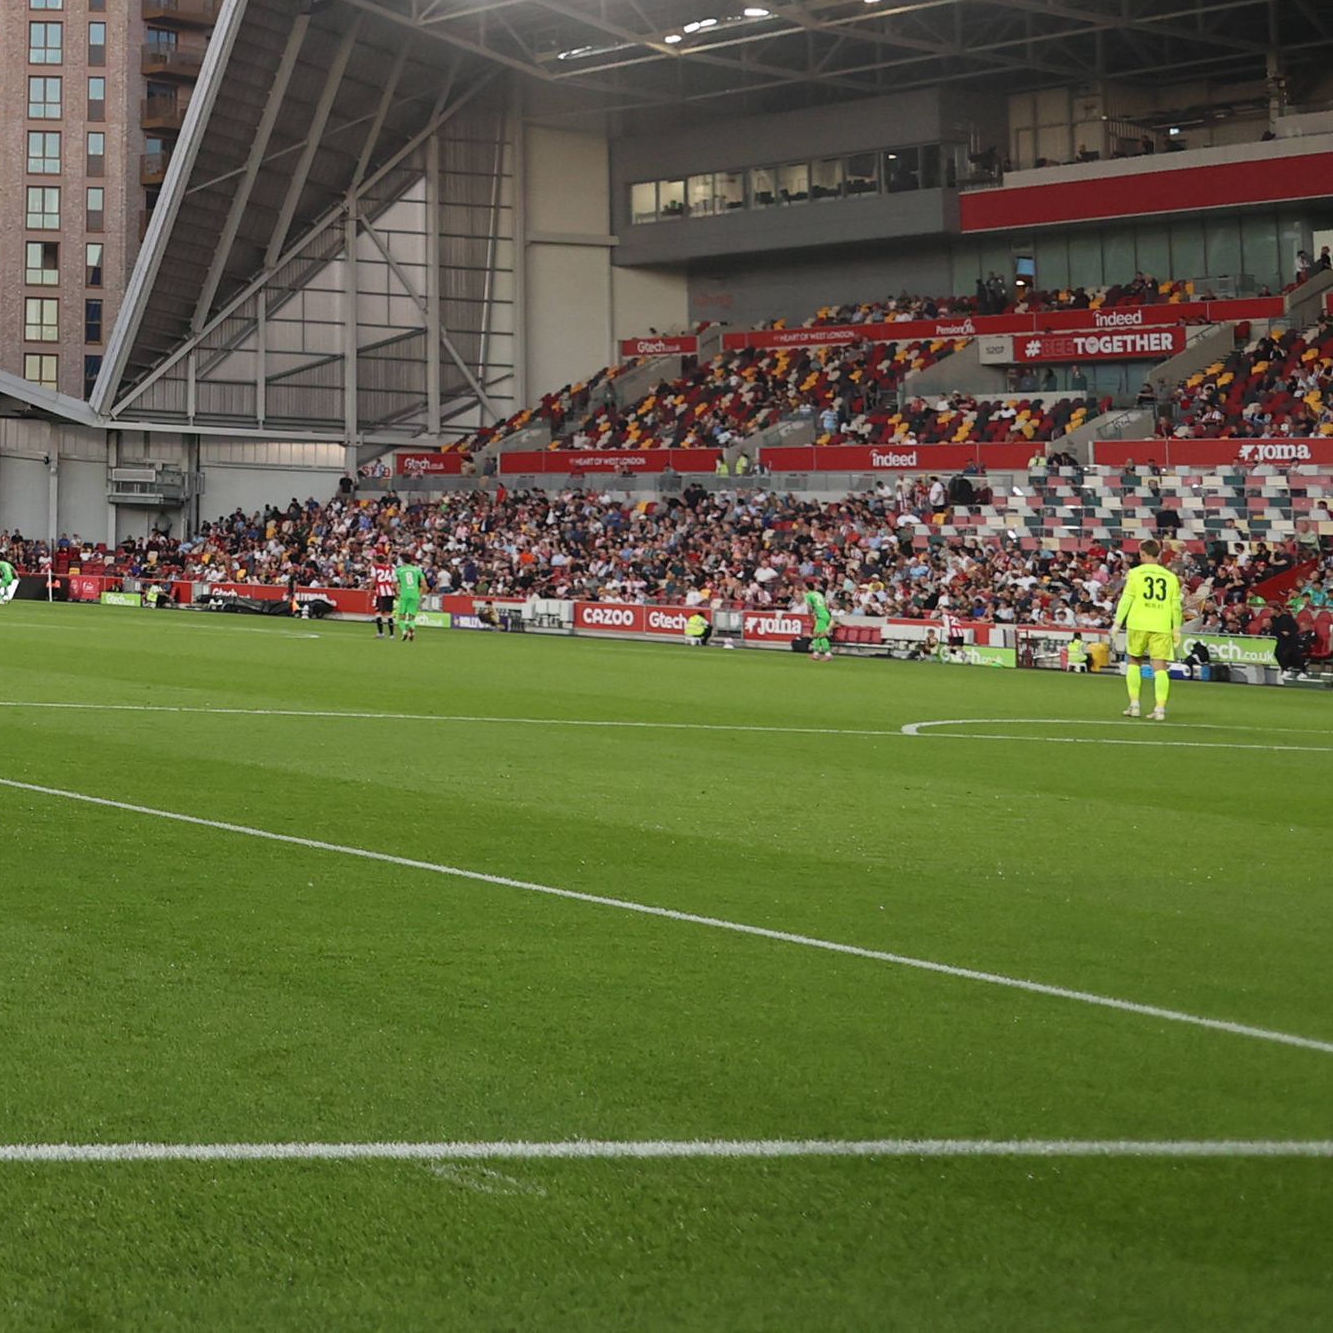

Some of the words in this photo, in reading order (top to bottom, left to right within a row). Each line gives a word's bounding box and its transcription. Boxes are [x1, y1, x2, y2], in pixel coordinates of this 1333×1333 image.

[1093, 310, 1142, 328] indeed
[869, 449, 917, 467] indeed
[376, 569, 392, 583] 24
[405, 571, 415, 586] 8
[1143, 576, 1167, 602] 33
[582, 608, 634, 626] CAZOO
